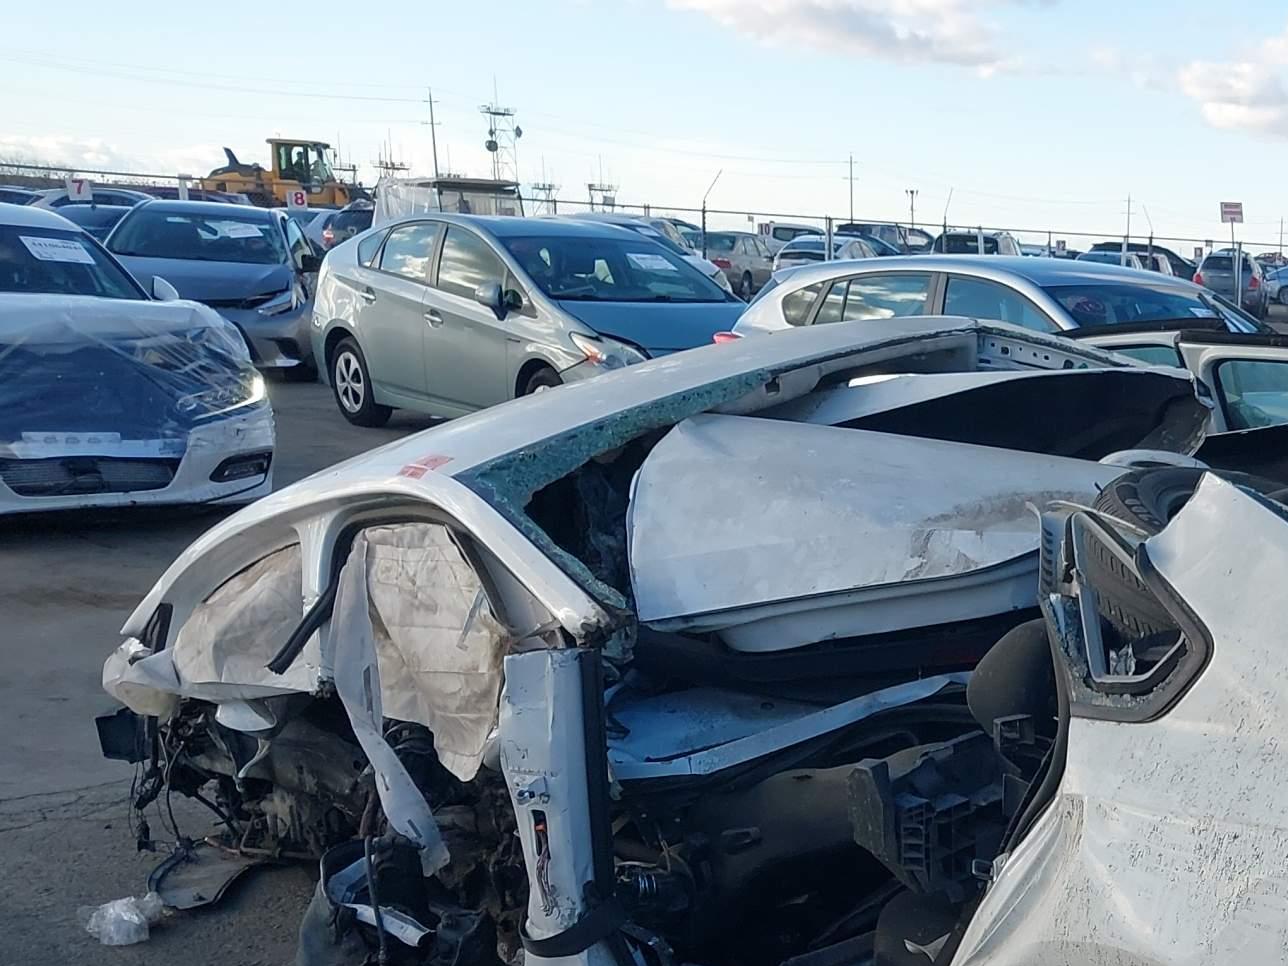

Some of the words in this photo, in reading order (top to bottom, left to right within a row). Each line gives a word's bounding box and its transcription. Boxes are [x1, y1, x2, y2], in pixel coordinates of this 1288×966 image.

[71, 179, 83, 195] 7
[294, 191, 305, 206] 8
[760, 223, 770, 236] 10
